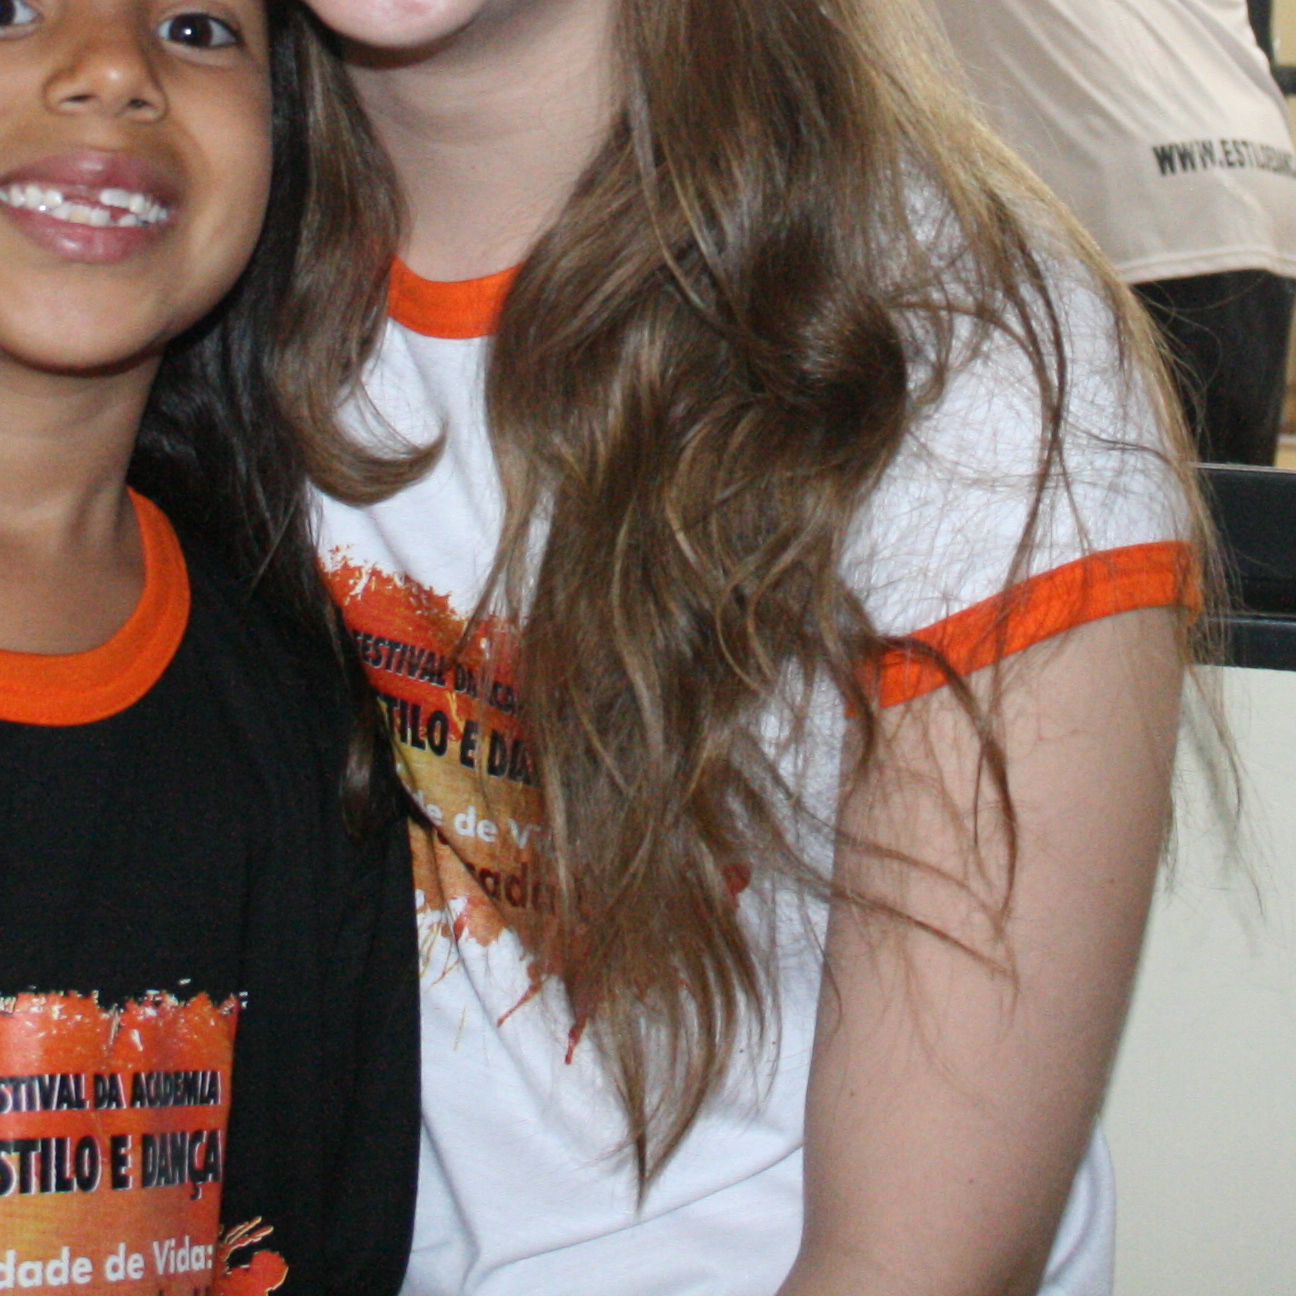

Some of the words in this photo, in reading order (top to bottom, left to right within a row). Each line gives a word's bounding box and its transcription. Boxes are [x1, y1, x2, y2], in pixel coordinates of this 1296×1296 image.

[453, 805, 500, 843] de
[94, 1072, 127, 1109] DA
[132, 1070, 223, 1109] ACADEMIA
[111, 1134, 133, 1191] E
[141, 1129, 223, 1201] DANÇA
[103, 1242, 145, 1283] de
[152, 1235, 214, 1275] Vida:
